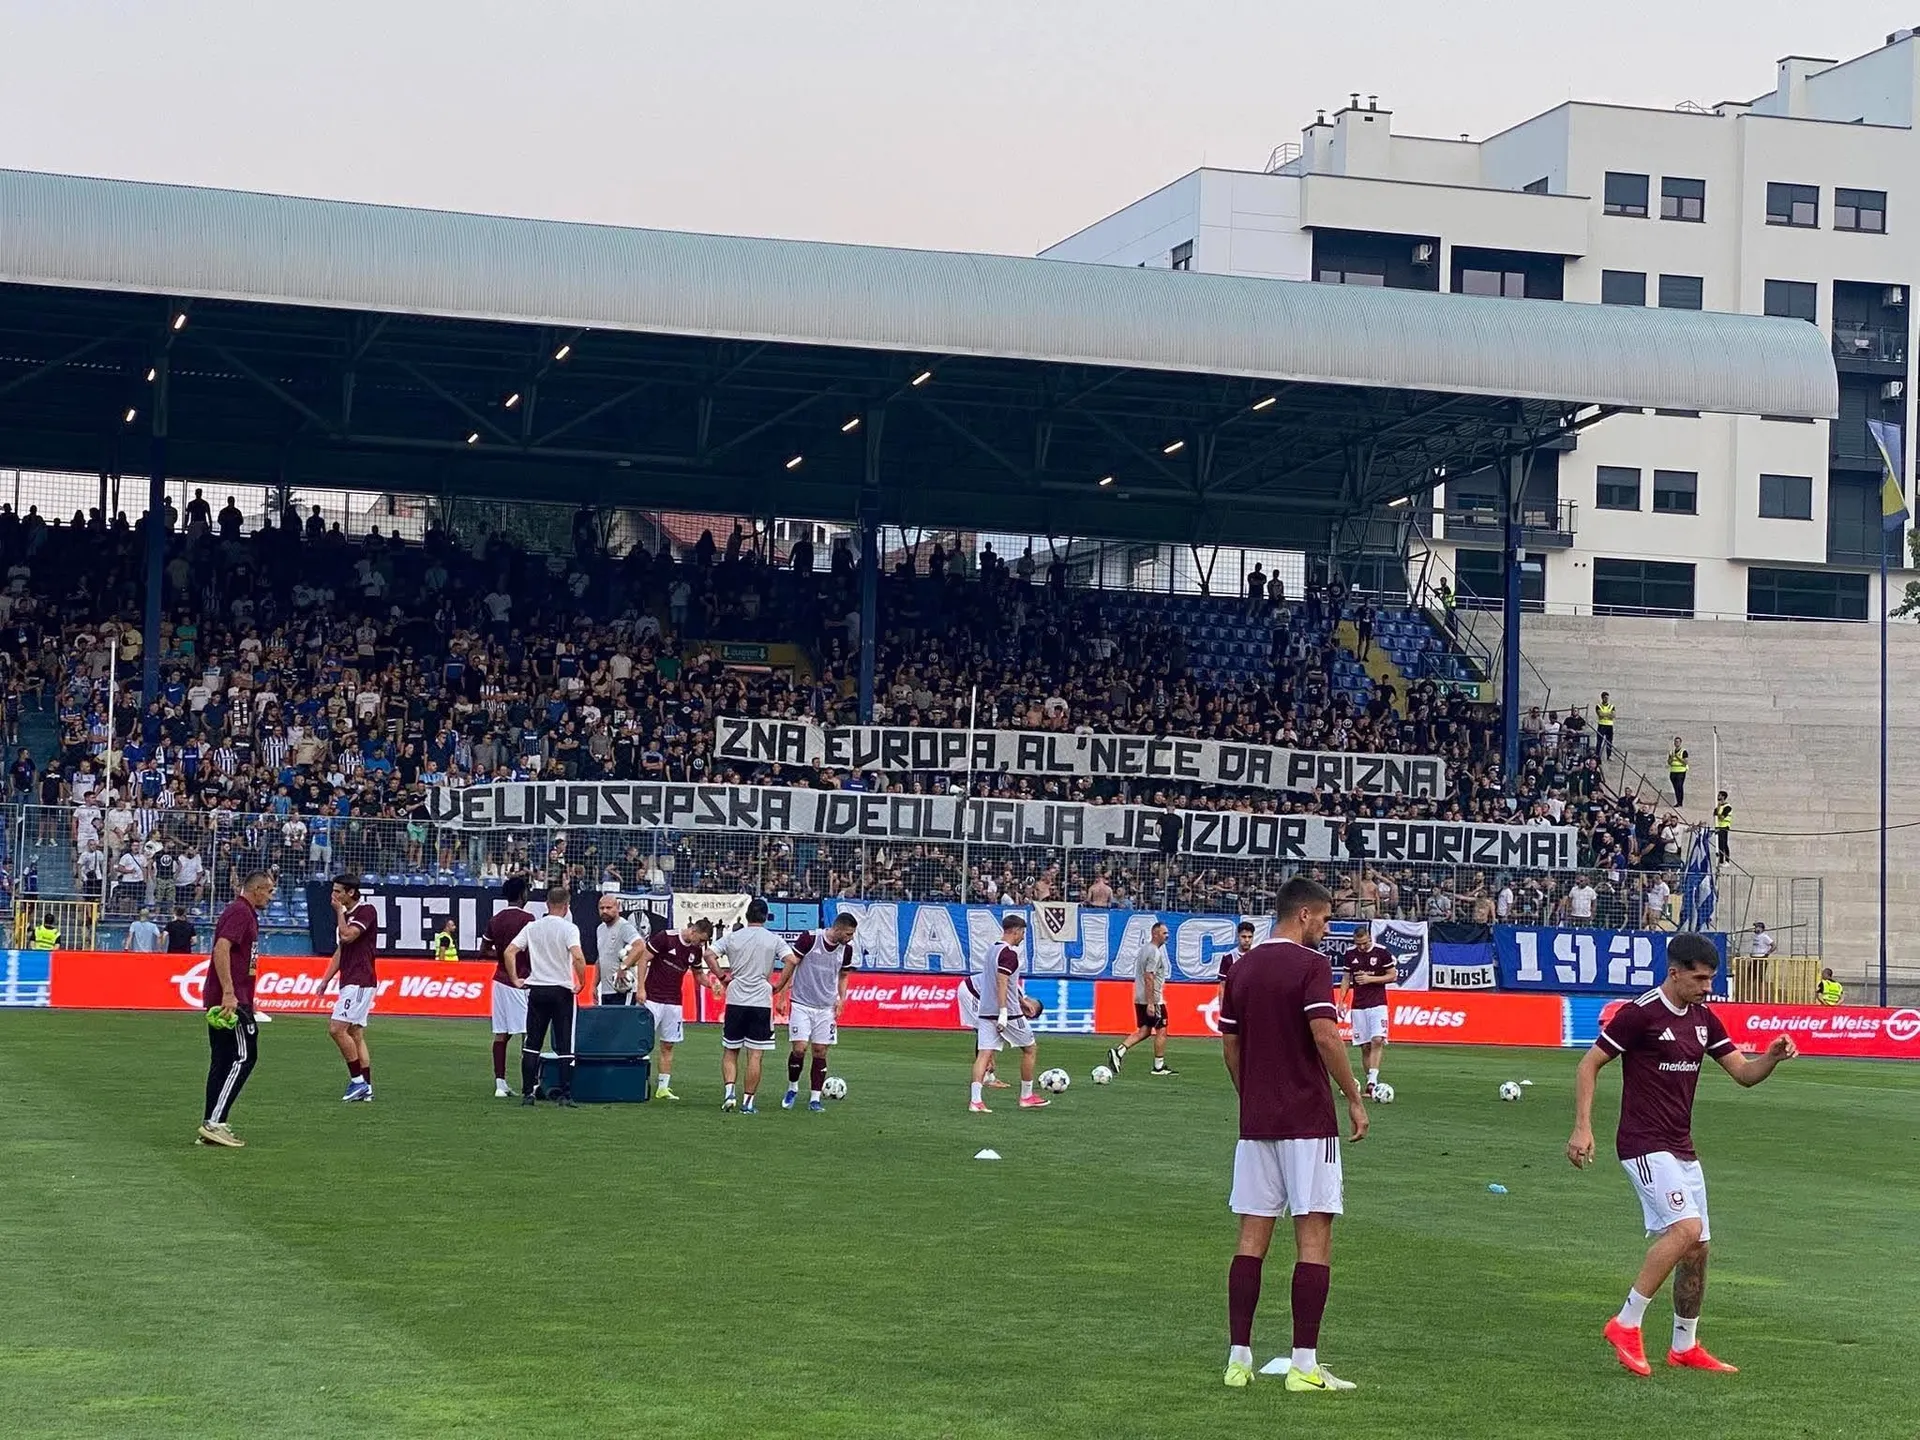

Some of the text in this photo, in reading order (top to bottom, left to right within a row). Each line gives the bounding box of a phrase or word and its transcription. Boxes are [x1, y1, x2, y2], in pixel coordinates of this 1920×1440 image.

[722, 720, 806, 763] ZNA
[1217, 745, 1272, 784] DA
[1287, 753, 1437, 797] PRIZNA
[429, 786, 792, 830] VELIKOSRPSKA
[814, 794, 1084, 845] IDEOLOGIJA
[1181, 813, 1307, 858] IZVOR
[399, 976, 484, 999] Weiss
[900, 985, 957, 1001] Weiss
[344, 998, 352, 1010] 6
[1393, 1005, 1467, 1027] Weiss
[1746, 1015, 1881, 1030] Gebrüder Weiss
